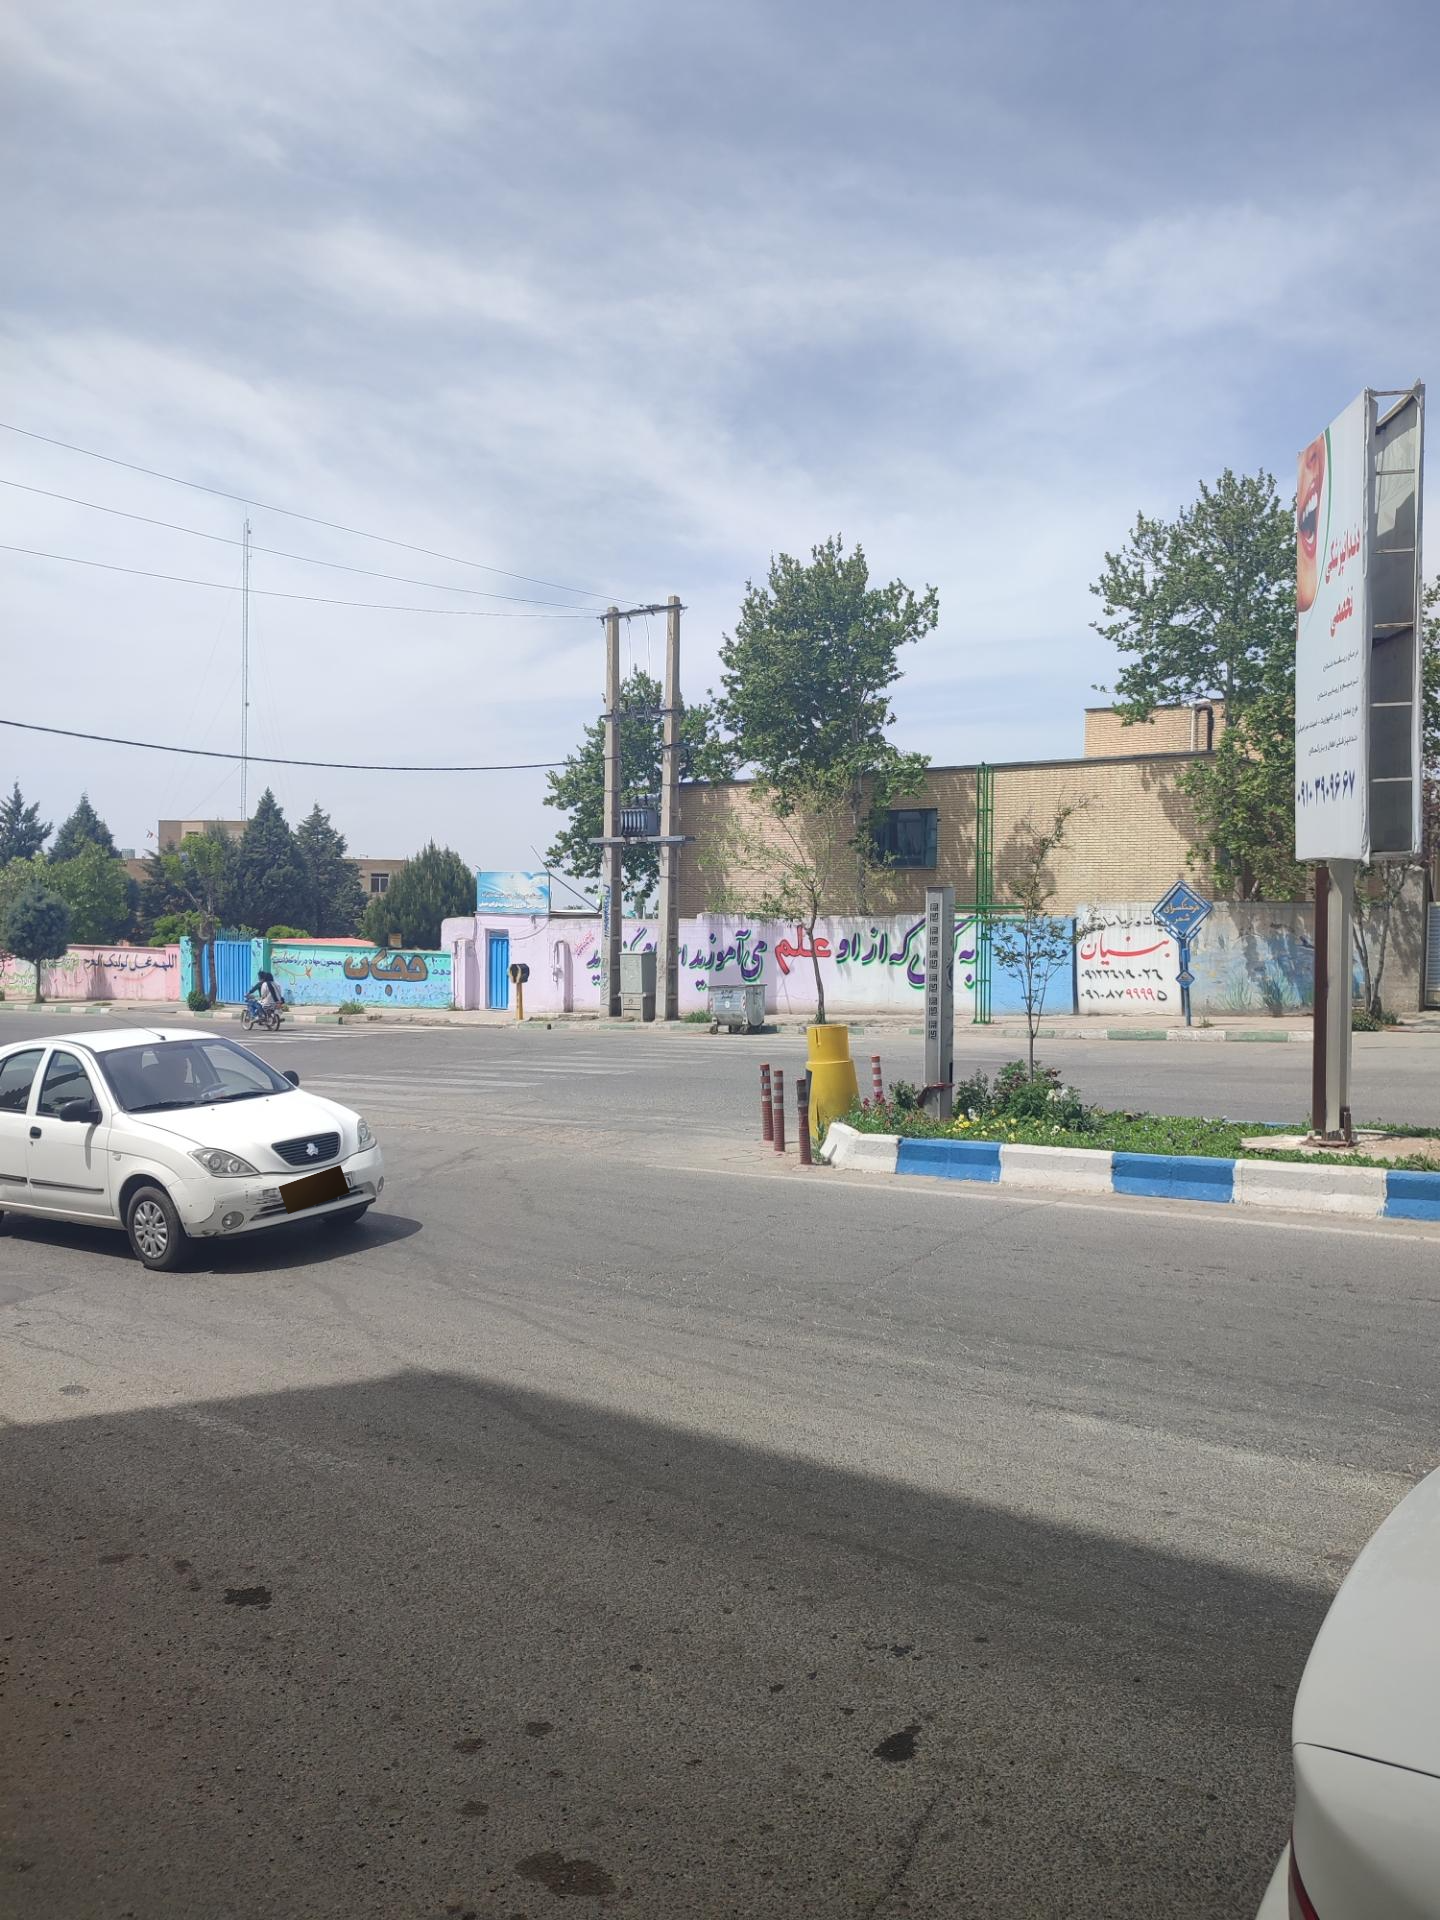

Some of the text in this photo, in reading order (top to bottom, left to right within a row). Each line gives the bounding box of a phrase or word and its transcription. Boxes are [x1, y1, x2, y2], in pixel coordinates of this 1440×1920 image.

[740, 940, 767, 983] می
[775, 924, 832, 976] علم
[836, 933, 860, 964] او
[862, 926, 888, 966] از
